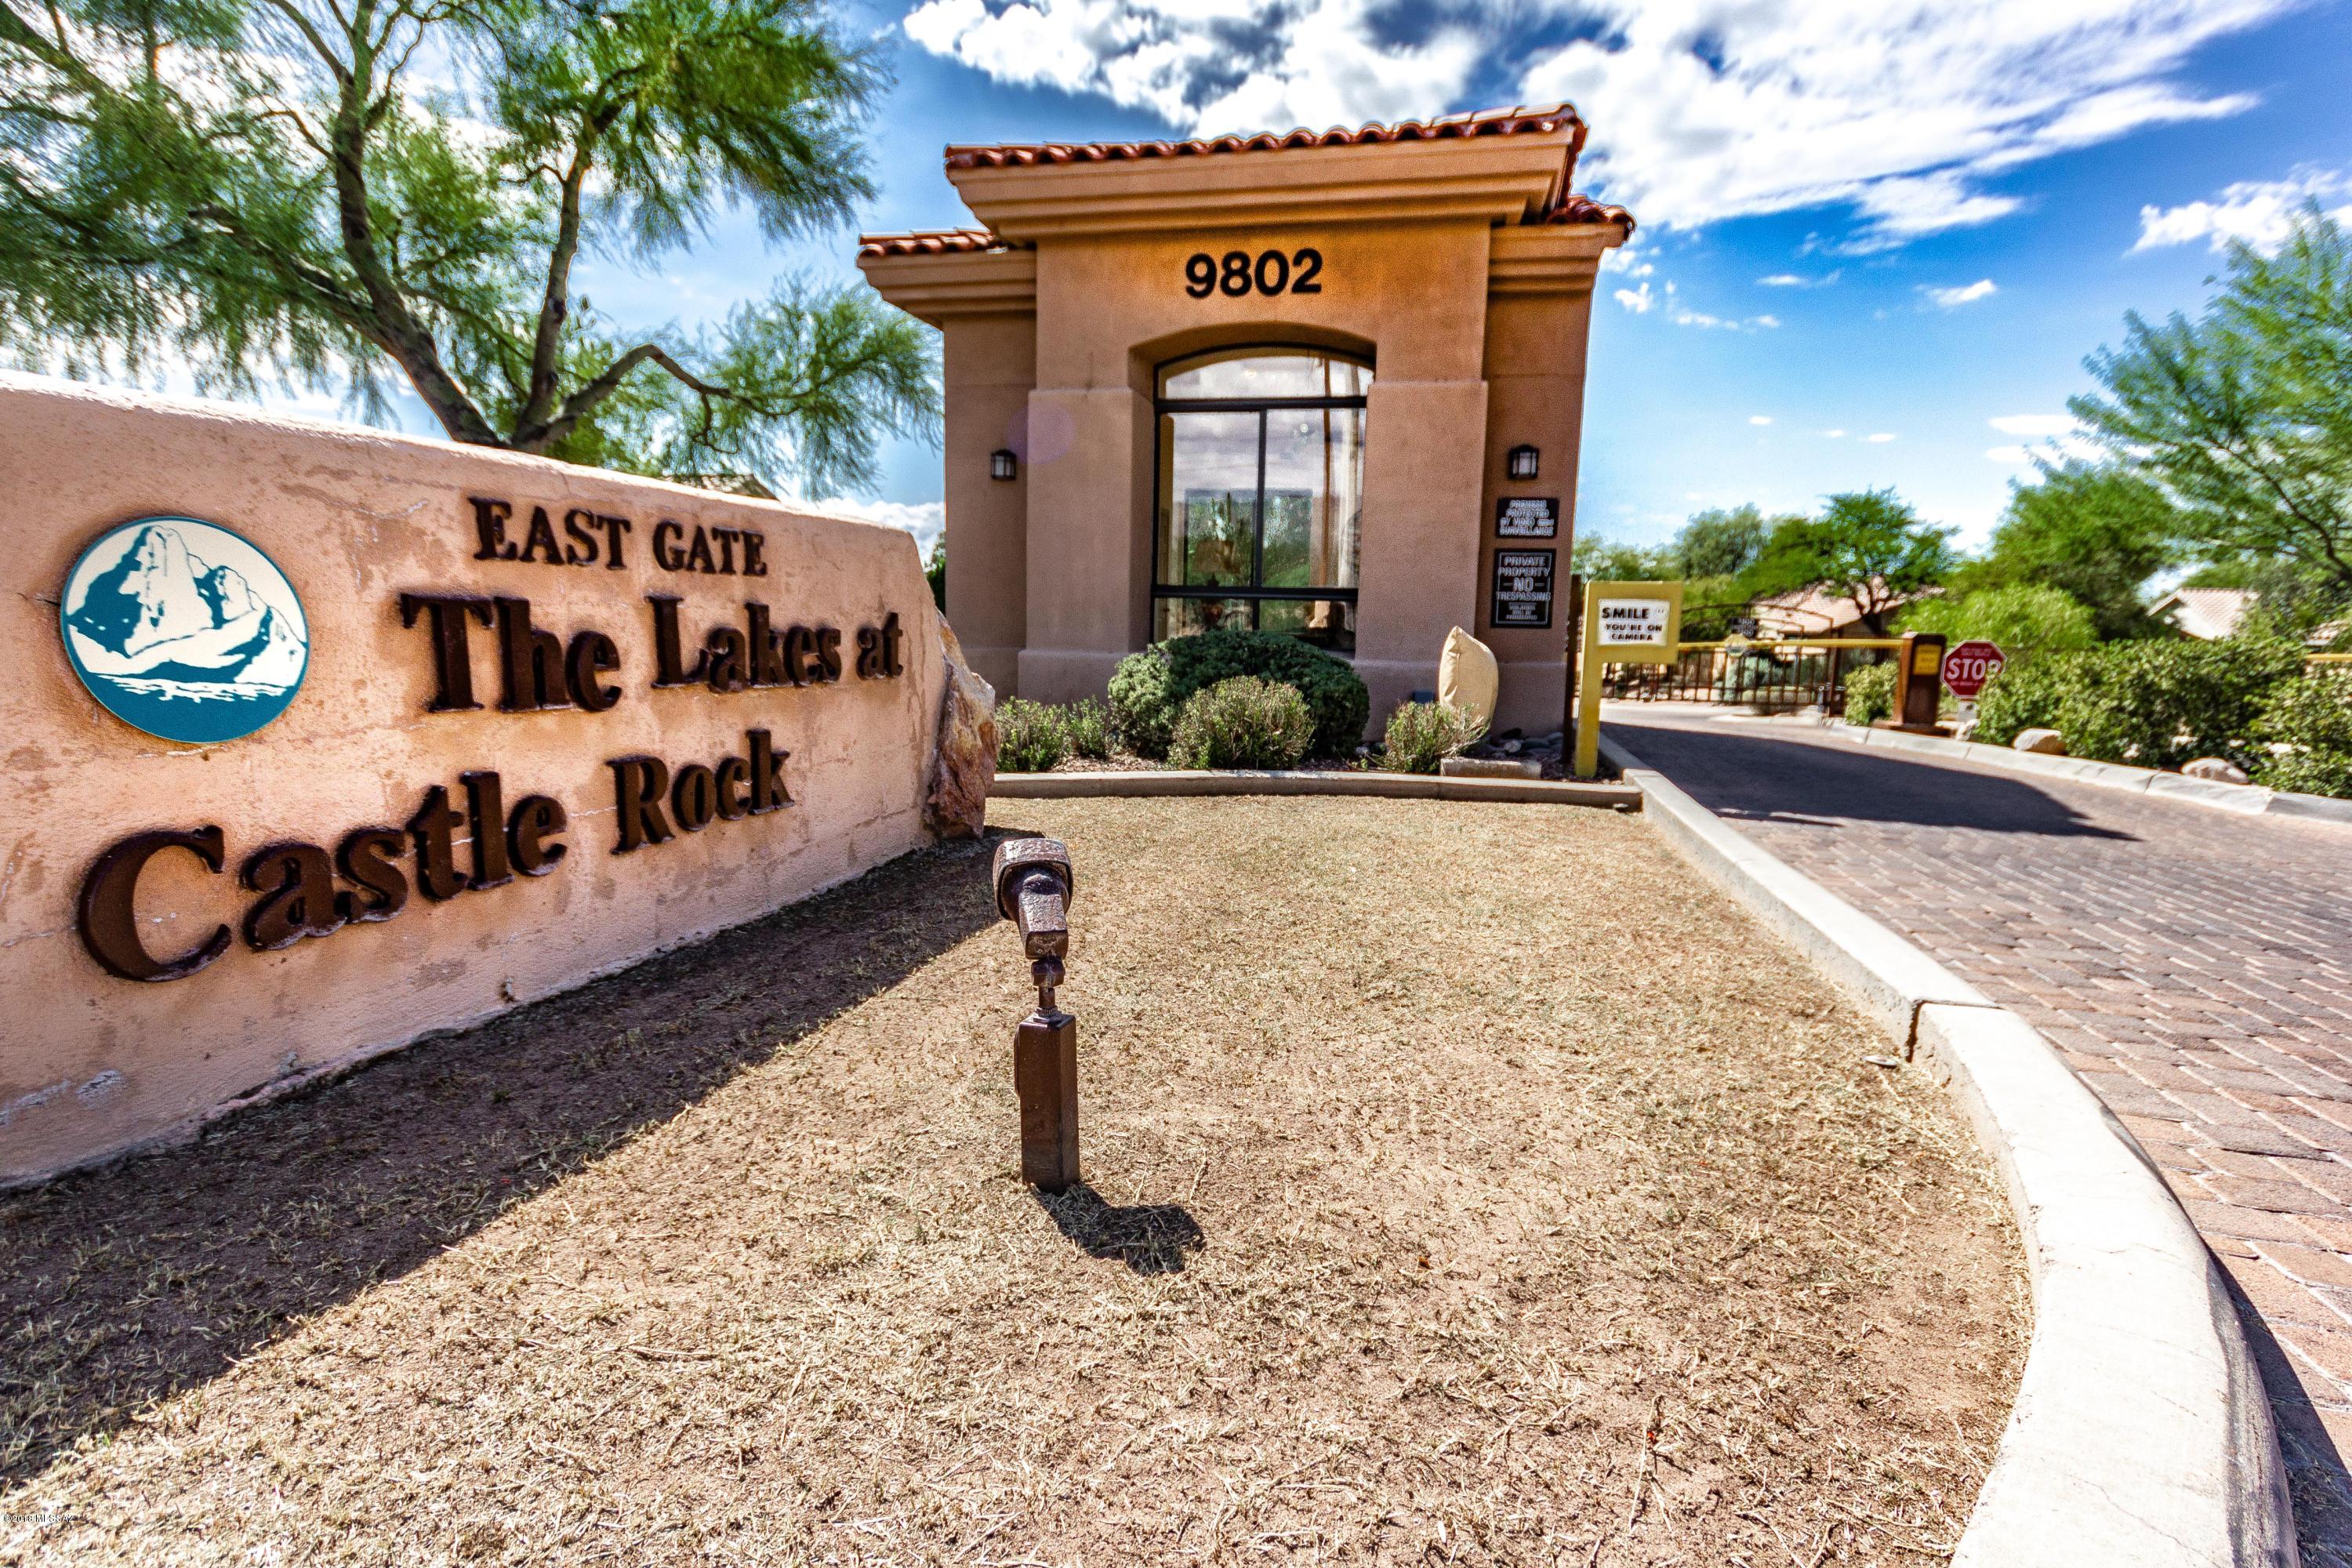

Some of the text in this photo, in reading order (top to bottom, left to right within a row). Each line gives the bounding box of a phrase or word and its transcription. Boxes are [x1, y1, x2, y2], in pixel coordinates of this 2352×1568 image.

[1185, 248, 1323, 299] 9802
[469, 497, 768, 575] EAST GATE
[1500, 526, 1553, 535] SURVEILLANCE
[1504, 557, 1545, 566] PRIVATE
[1498, 567, 1550, 576] PROPERTY
[1513, 577, 1534, 591] NO
[1496, 591, 1551, 601] TRESPASSING
[1602, 608, 1650, 619] SMILE
[400, 593, 904, 712] The Lakes at
[1947, 658, 2002, 681] STOP
[78, 728, 795, 982] Castle Rock
